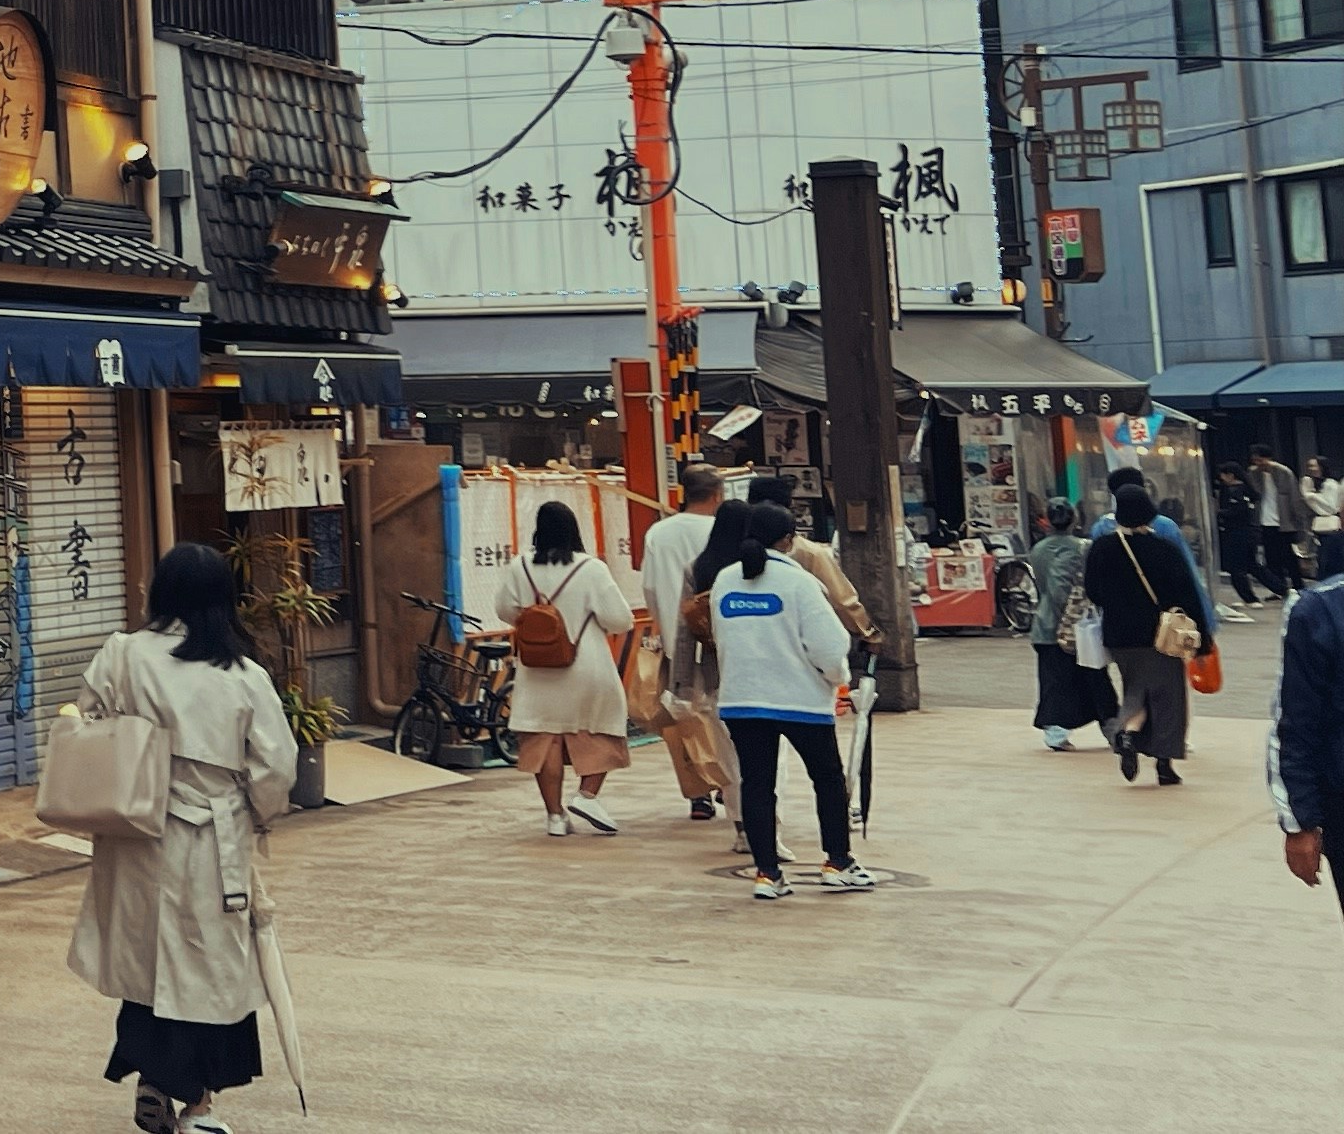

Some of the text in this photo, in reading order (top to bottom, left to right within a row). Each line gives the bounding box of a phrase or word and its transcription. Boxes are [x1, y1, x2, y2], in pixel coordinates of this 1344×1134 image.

[890, 142, 959, 213] 楓
[476, 182, 572, 213] 和菓子
[604, 216, 642, 237] かえ
